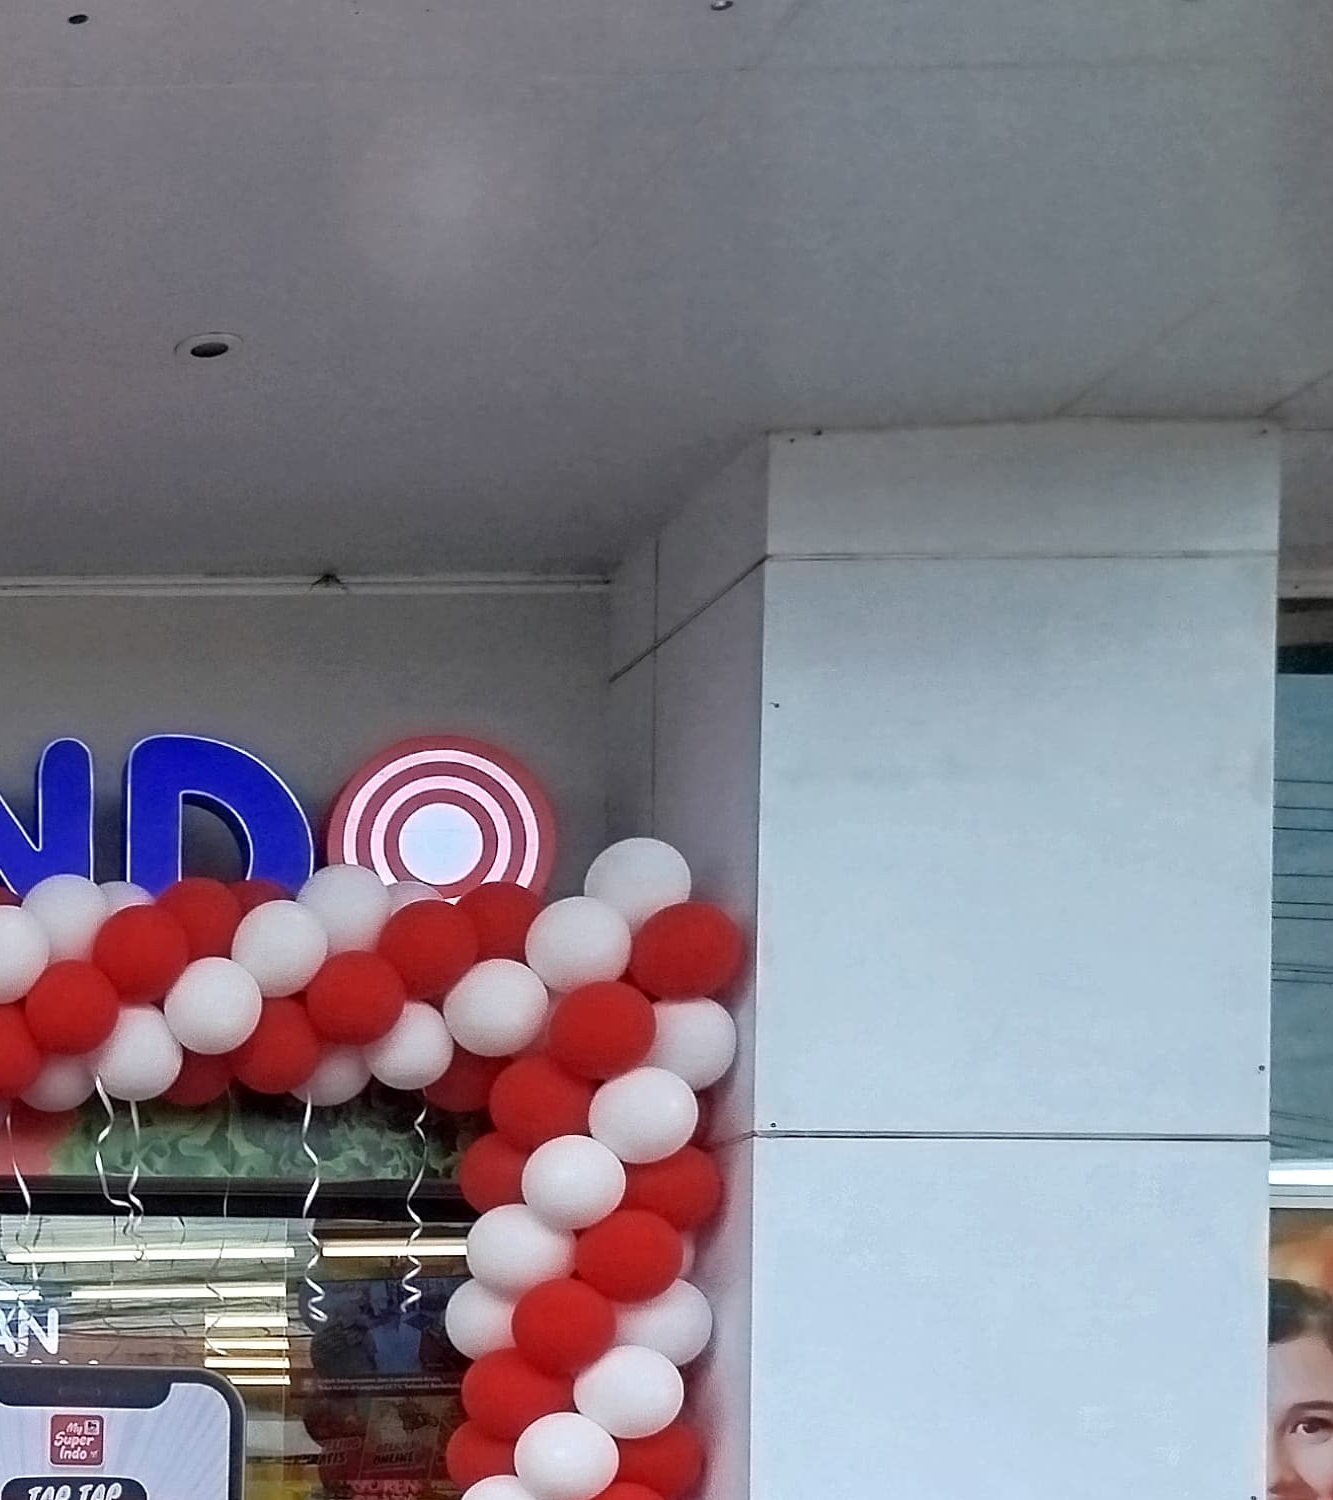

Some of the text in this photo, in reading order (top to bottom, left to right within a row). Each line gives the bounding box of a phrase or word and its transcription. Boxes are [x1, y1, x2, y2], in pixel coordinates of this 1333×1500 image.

[66, 1421, 83, 1435] My
[53, 1431, 95, 1449] Super
[58, 1446, 88, 1461] Indo
